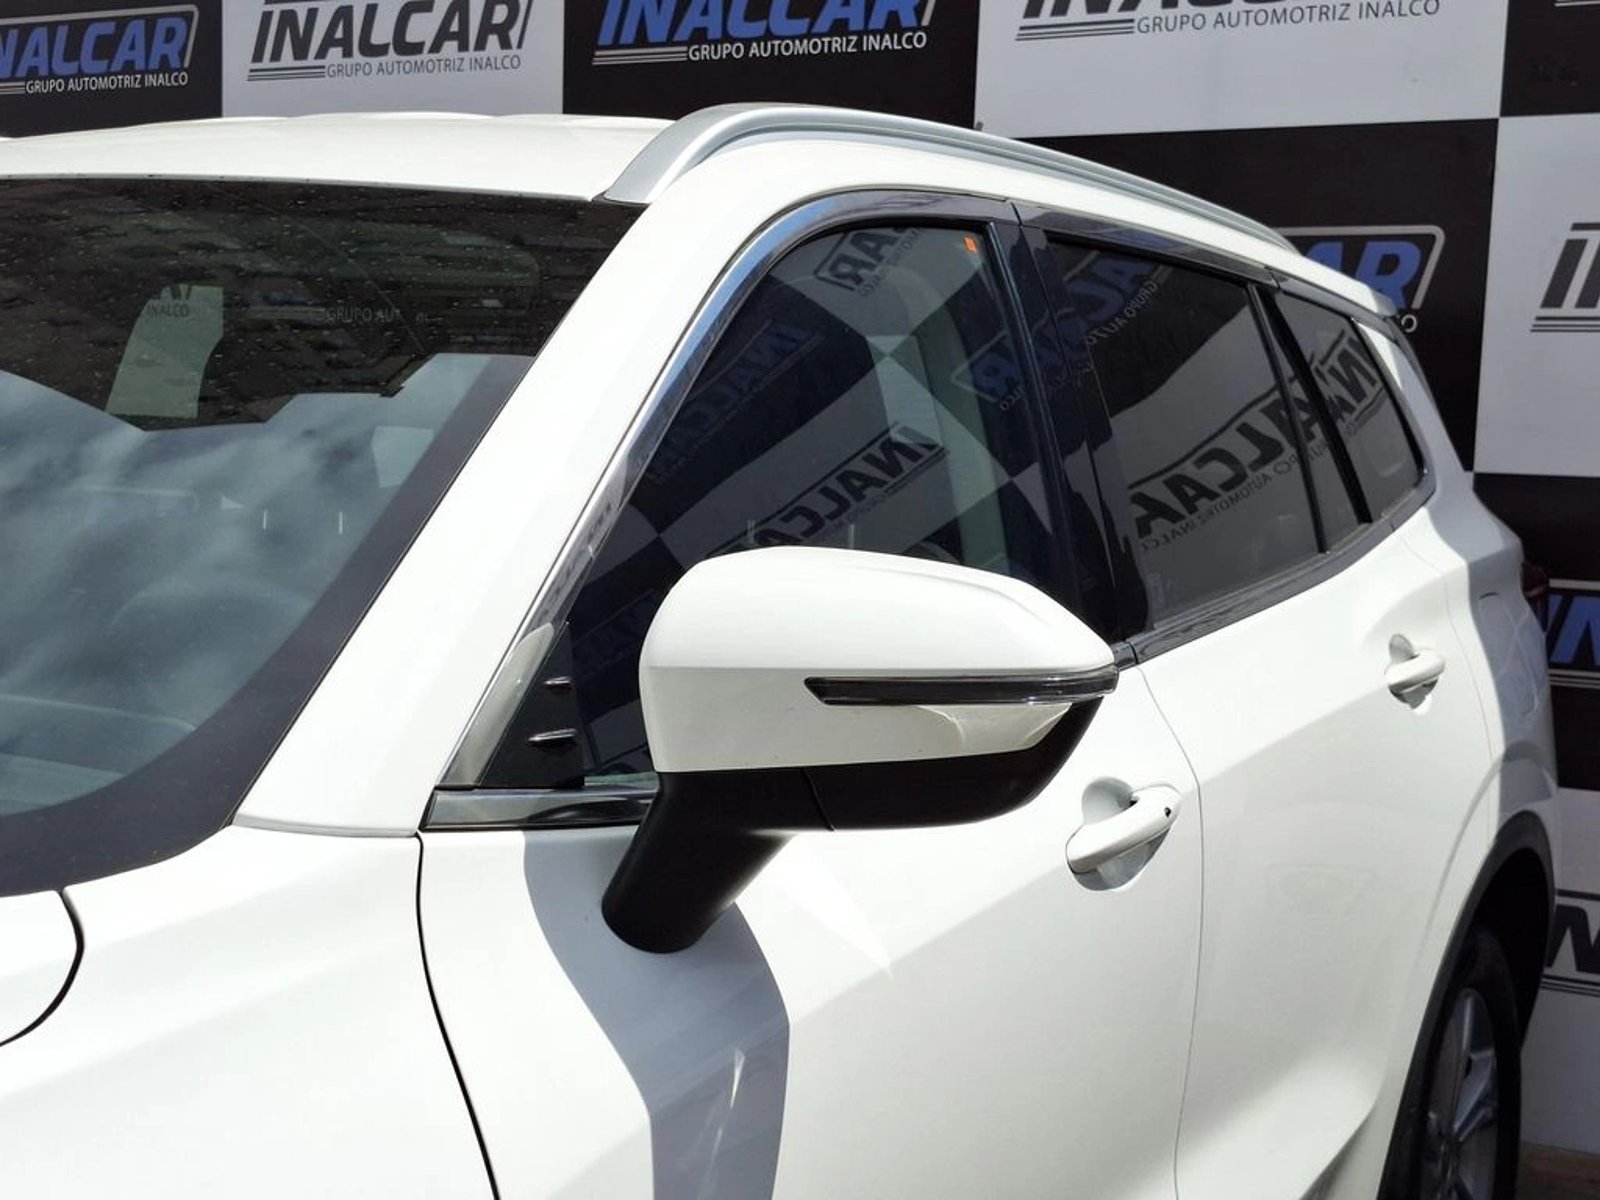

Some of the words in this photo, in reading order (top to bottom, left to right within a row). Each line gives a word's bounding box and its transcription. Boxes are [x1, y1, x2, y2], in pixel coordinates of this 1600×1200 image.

[251, 0, 520, 63] INALCAR
[1136, 12, 1207, 34] GRUPO
[1212, 2, 1351, 29] AUTOMOTRIZ
[1357, 0, 1440, 20] INALCO
[688, 42, 744, 61] GRUPO
[748, 36, 858, 58] AUTOMOTRIZ
[862, 31, 927, 51] INALCO
[327, 62, 372, 78] GRUPO
[377, 57, 464, 76] AUTOMOTRIZ
[469, 54, 521, 72] INALCO
[26, 78, 65, 94] GRUPO
[67, 74, 142, 92] AUTOMOTRIZ
[145, 71, 189, 88] INALCO
